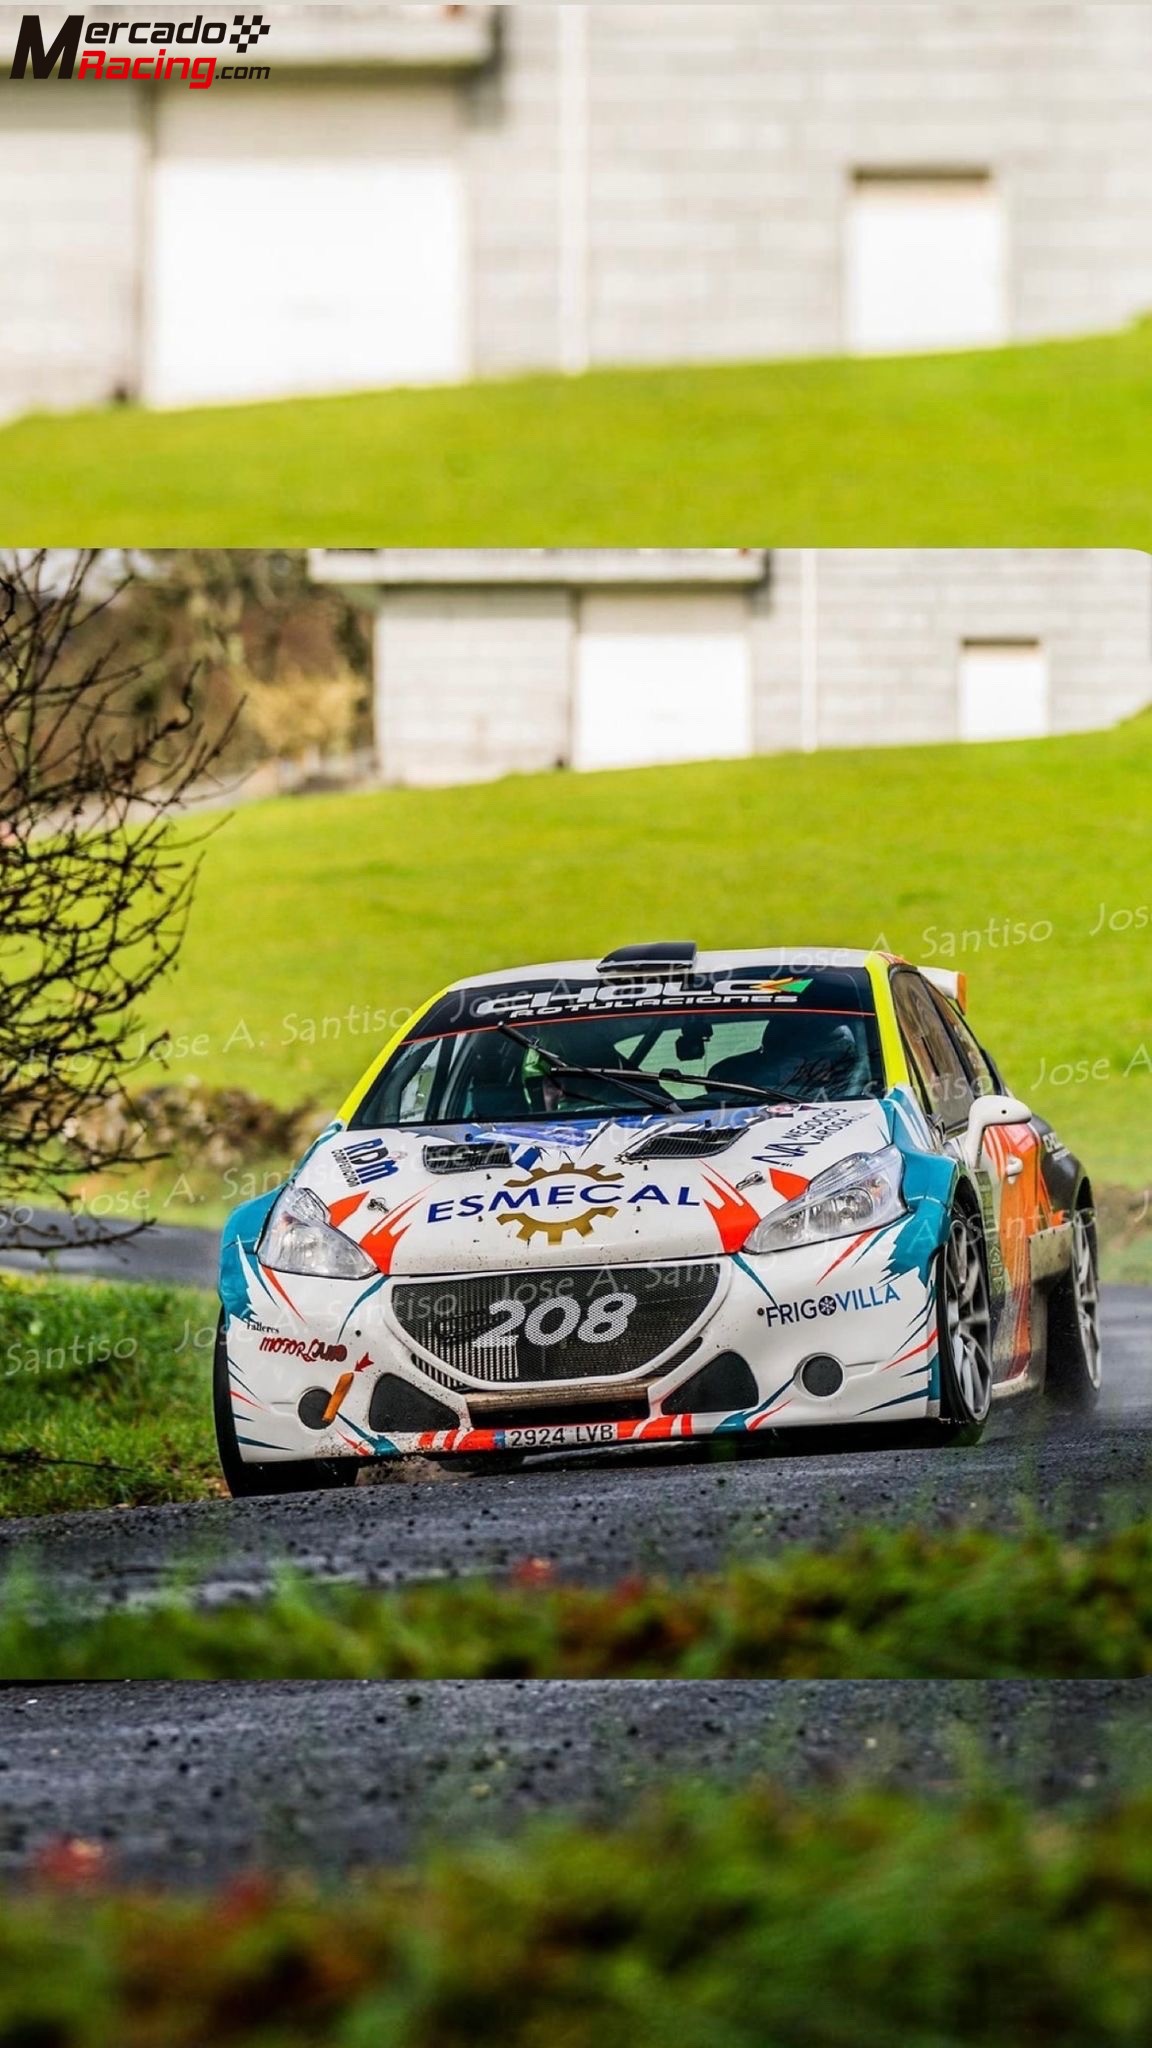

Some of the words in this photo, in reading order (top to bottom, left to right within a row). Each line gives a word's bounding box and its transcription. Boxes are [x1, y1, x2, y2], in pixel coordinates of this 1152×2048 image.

[509, 995, 798, 1019] ROTULACIONES
[781, 1107, 848, 1141] NEGOCIOS
[427, 1184, 701, 1224] ESMECAL
[246, 1320, 280, 1335] Talleres
[472, 1292, 638, 1349] 208
[510, 1427, 566, 1448] 2924
[576, 1424, 614, 1443] LVB
